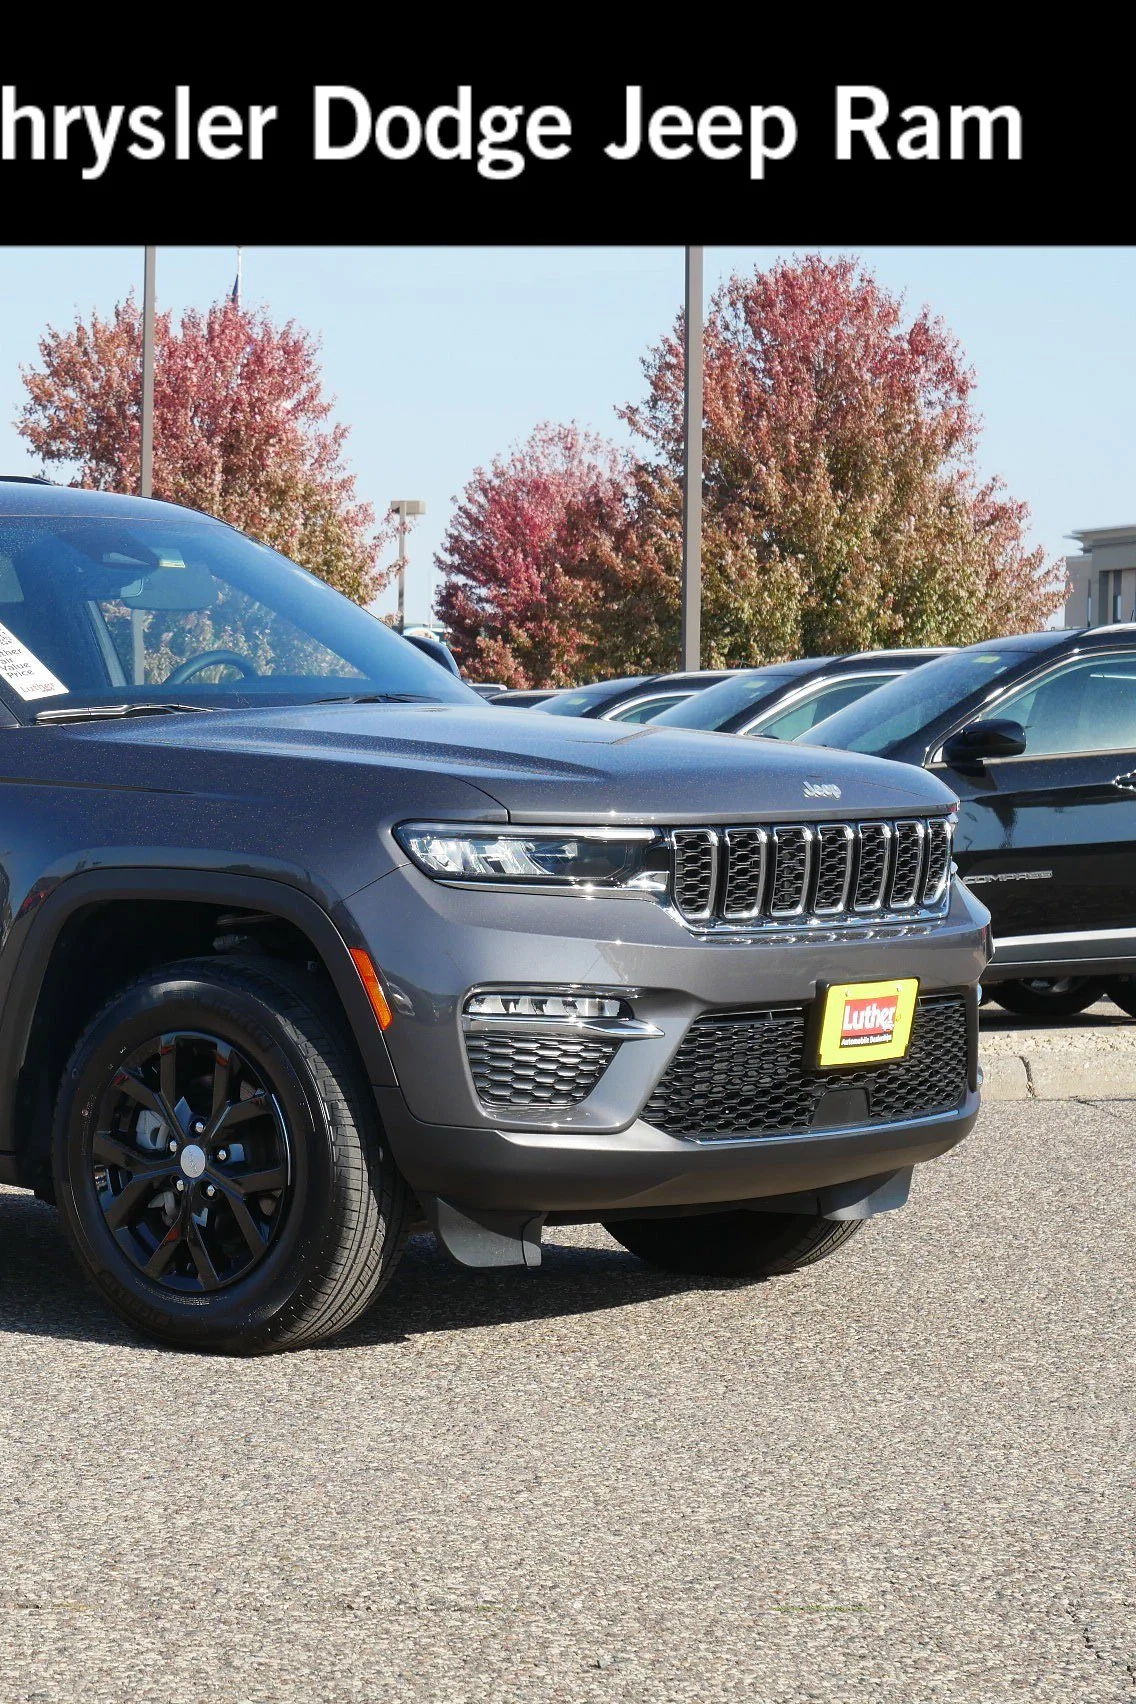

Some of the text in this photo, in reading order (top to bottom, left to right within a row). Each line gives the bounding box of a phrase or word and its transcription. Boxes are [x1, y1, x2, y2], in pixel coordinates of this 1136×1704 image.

[0, 662, 31, 672] Value
[6, 669, 35, 679] Price
[19, 681, 55, 693] Luther
[802, 781, 842, 800] Jeep
[842, 1003, 897, 1031] Luther
